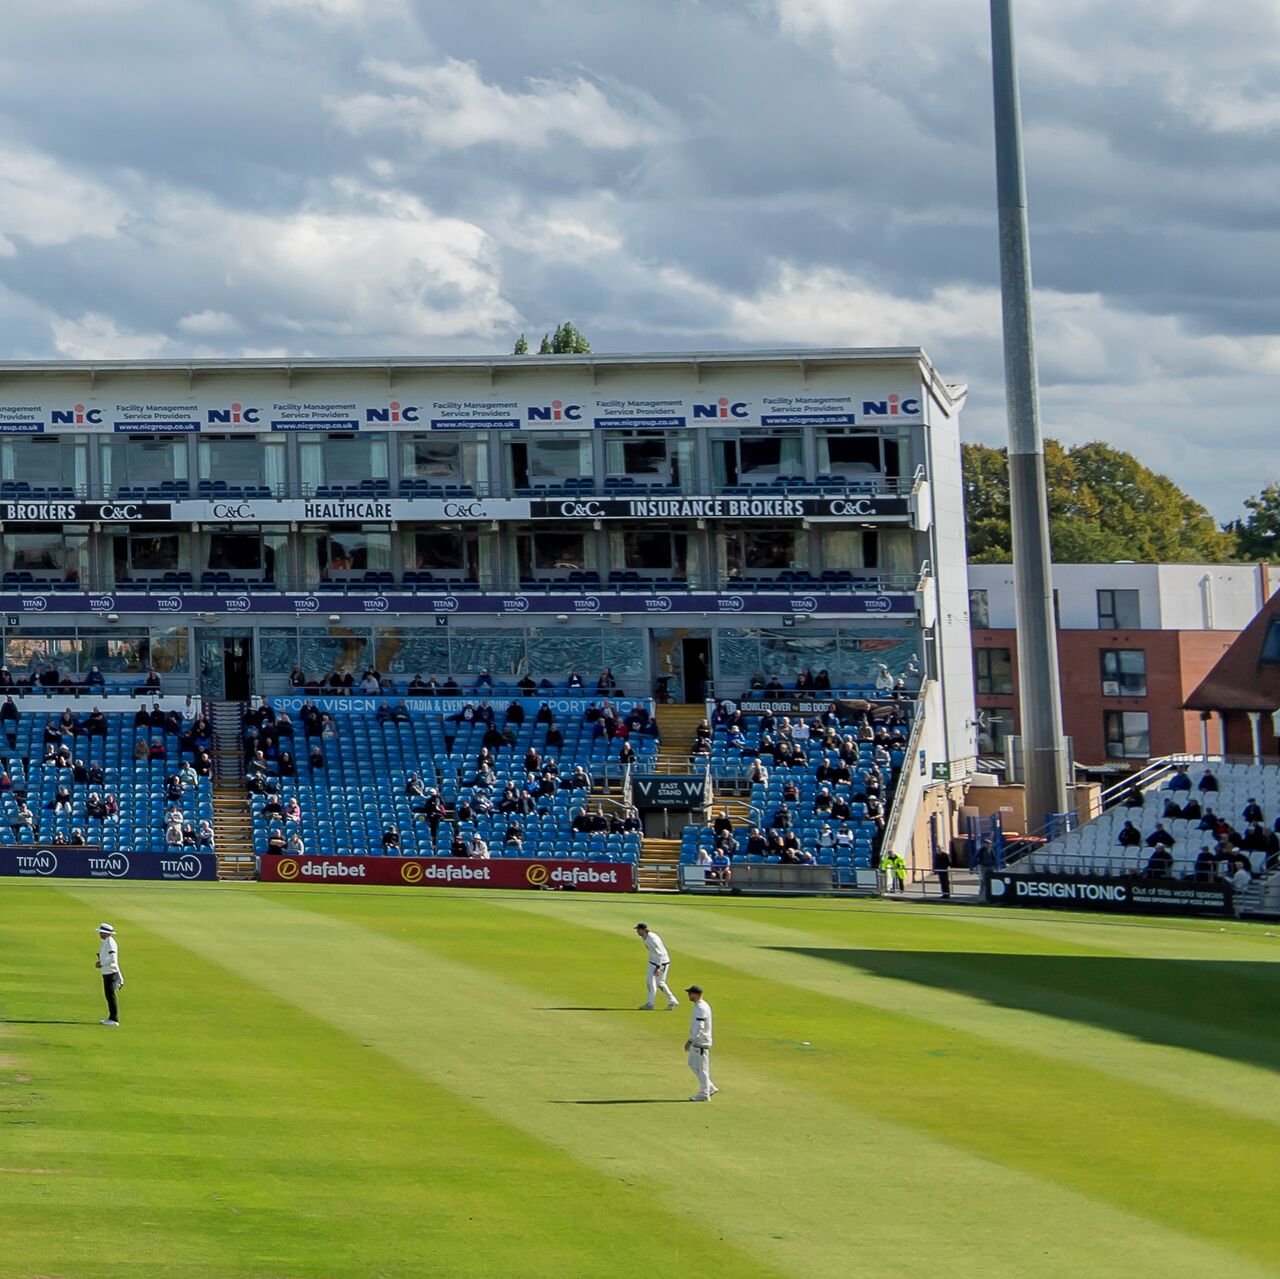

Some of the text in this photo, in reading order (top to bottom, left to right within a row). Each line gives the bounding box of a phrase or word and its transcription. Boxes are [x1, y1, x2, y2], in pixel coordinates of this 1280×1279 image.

[7, 504, 76, 520] BROKERS
[305, 504, 391, 517] HEALTHCARE
[629, 500, 723, 517] INSURANCE
[729, 500, 805, 516] BROKERS
[324, 699, 375, 711] VISION
[639, 782, 652, 795] V
[684, 782, 703, 795] W
[160, 861, 193, 871] TITAN
[301, 861, 365, 878] dafabet
[551, 867, 617, 884] dafabet
[1016, 881, 1126, 900] DESIGN TONIC
